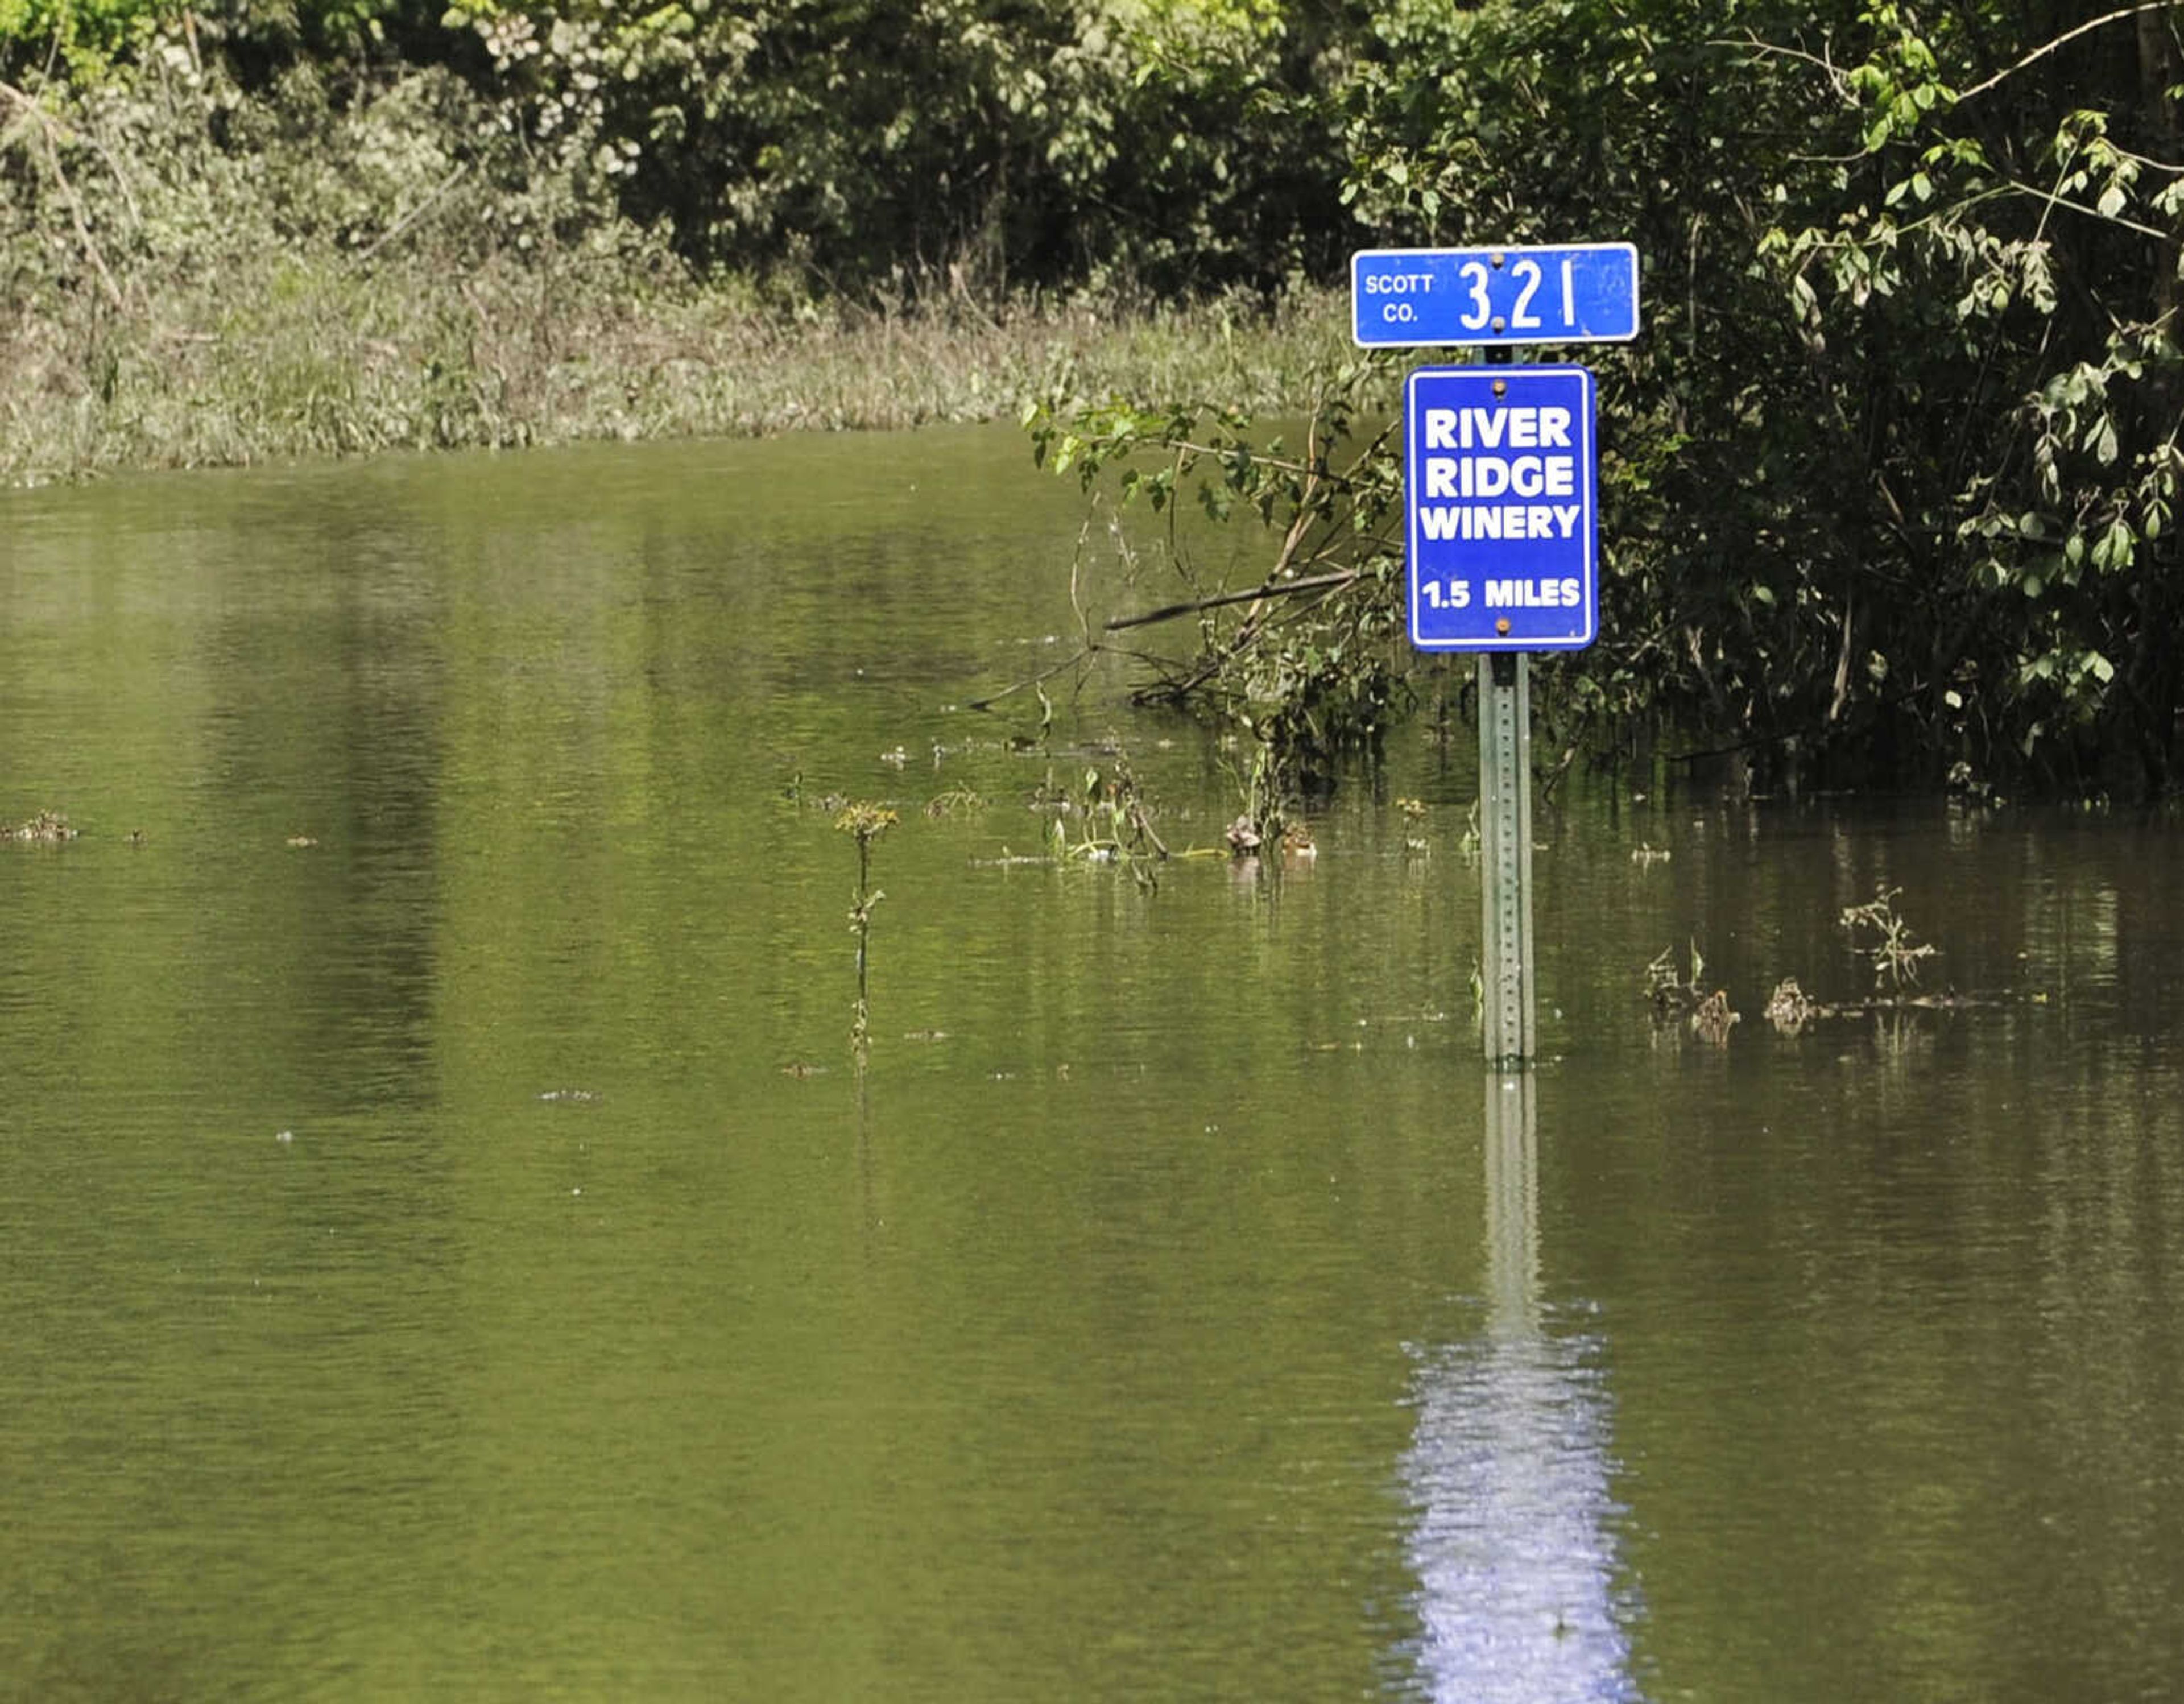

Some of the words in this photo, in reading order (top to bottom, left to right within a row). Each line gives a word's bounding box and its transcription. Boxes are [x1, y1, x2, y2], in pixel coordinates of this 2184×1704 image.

[1366, 274, 1434, 293] SCOTT
[1459, 259, 1574, 330] 321
[1383, 303, 1417, 322] CO.
[1426, 407, 1571, 449] RIVER
[1426, 456, 1573, 498] RIDGE
[1420, 505, 1580, 540] WINERY
[1422, 580, 1470, 608] 1.5
[1485, 578, 1581, 607] MILES
